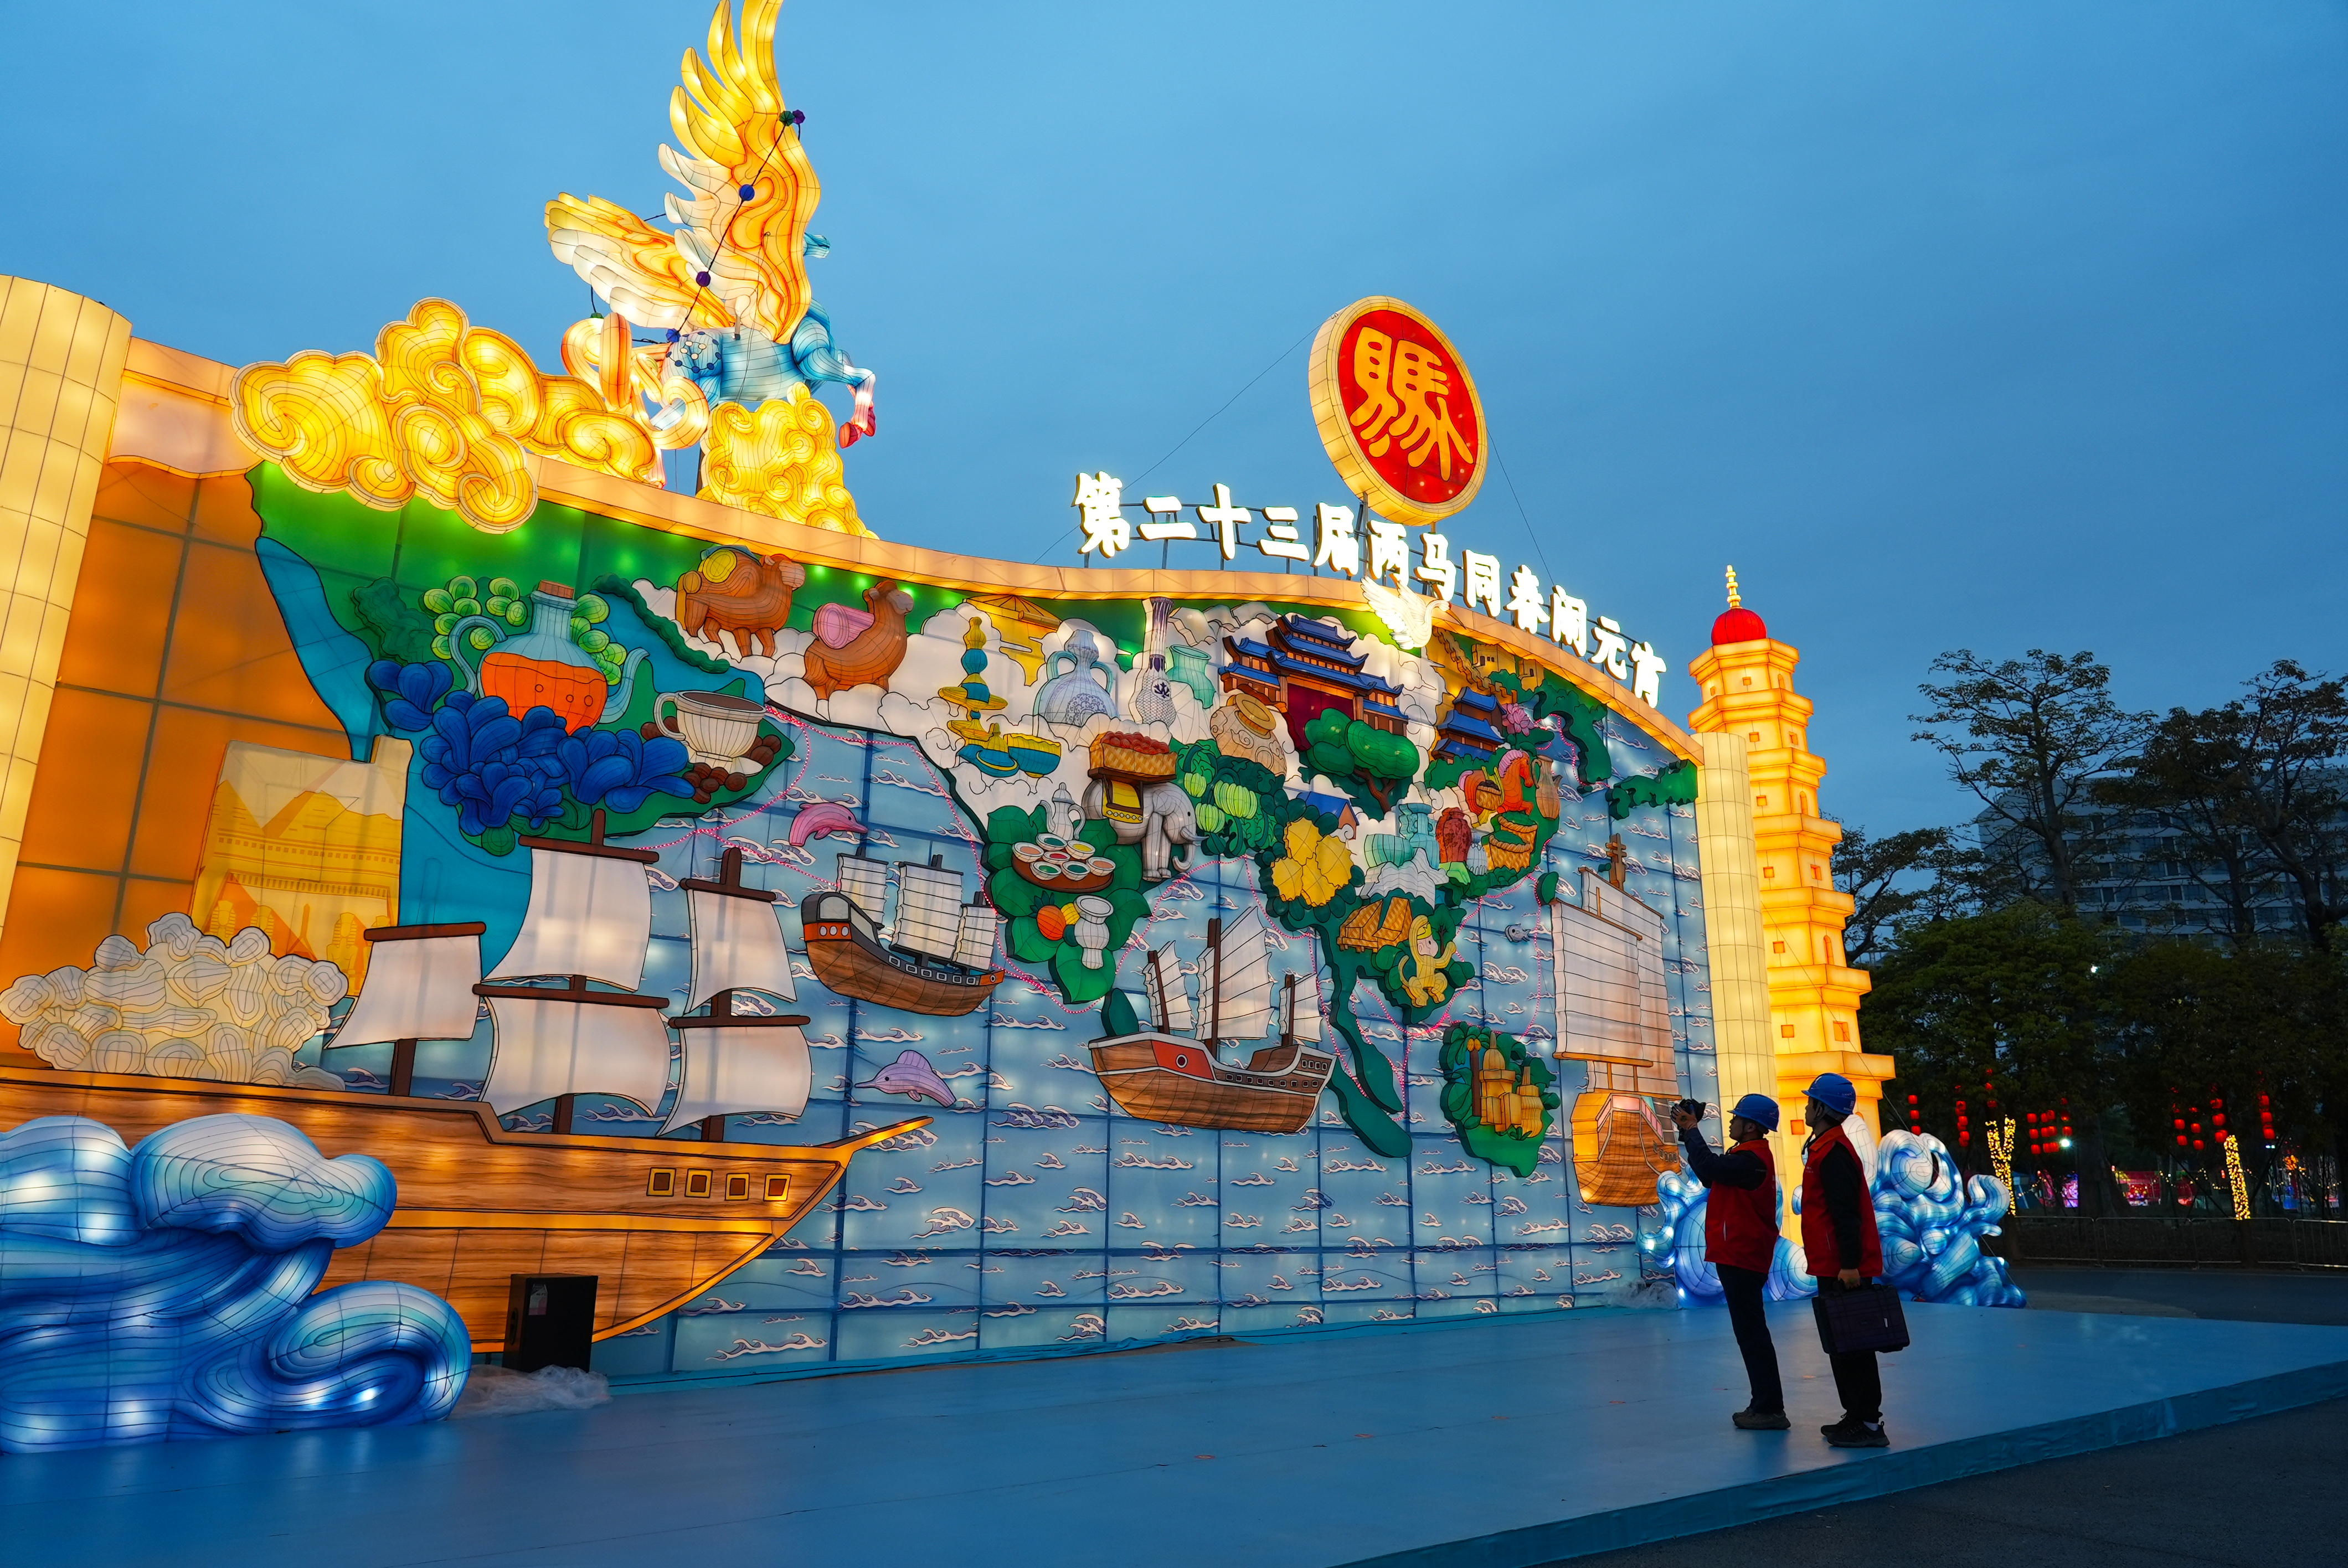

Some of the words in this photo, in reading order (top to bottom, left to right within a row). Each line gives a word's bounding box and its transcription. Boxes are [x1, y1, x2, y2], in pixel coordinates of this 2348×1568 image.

[1072, 471, 1667, 709] 第二十三届两马同春闹元宵
